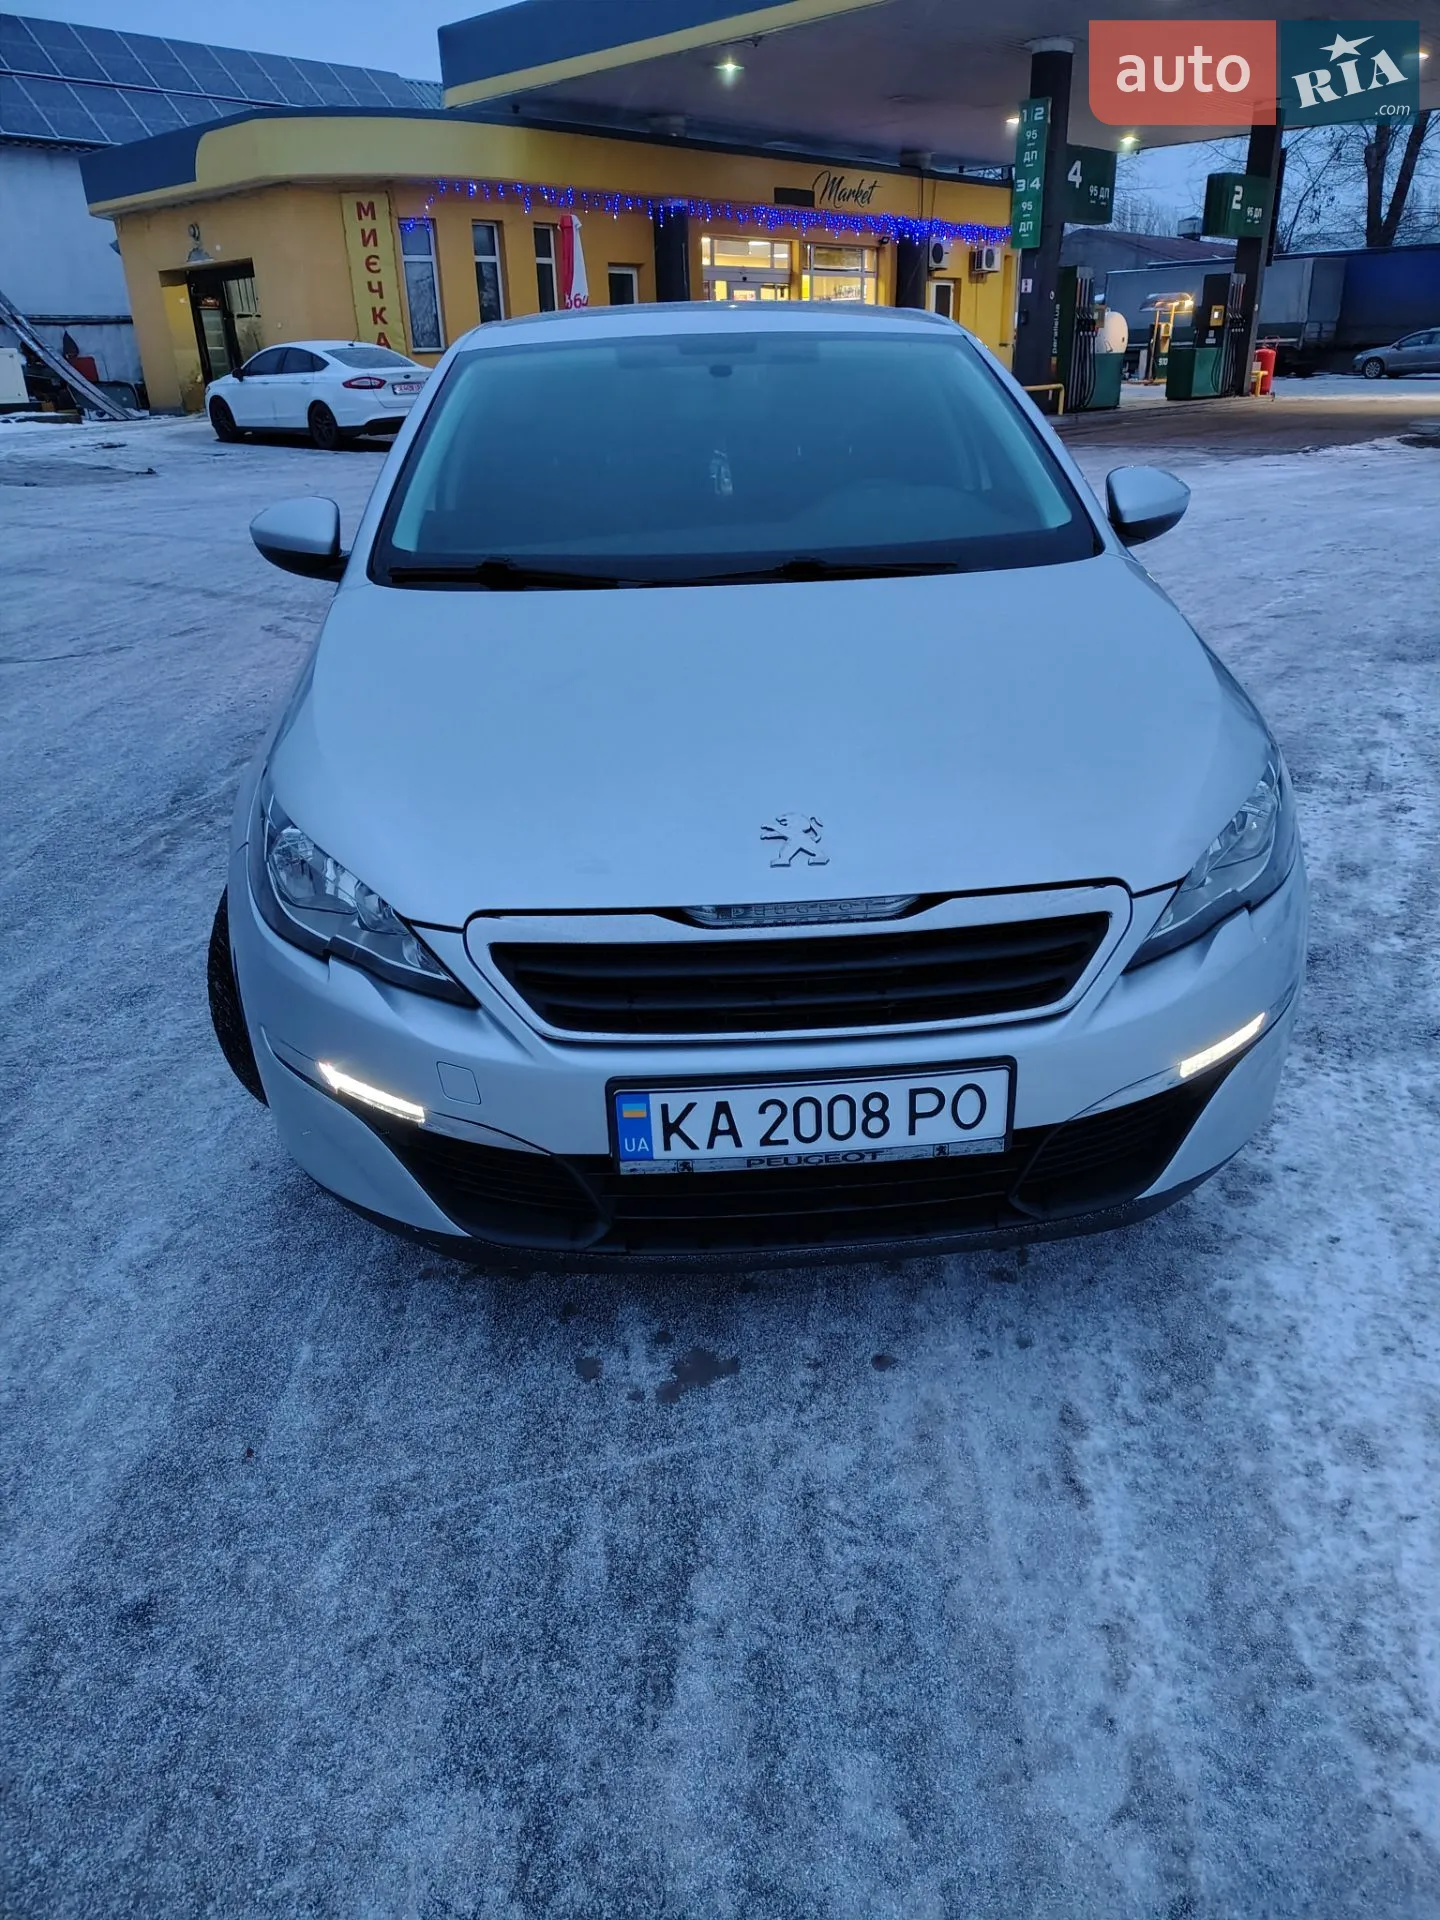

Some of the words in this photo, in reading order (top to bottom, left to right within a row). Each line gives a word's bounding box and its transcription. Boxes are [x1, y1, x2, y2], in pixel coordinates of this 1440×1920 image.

[1025, 129, 1038, 140] 95
[1023, 151, 1038, 163] ДП
[1067, 160, 1082, 189] 4
[812, 170, 882, 208] Market
[1089, 185, 1098, 197] 95
[1099, 187, 1110, 199] ДП
[1231, 185, 1243, 210] 2
[1021, 201, 1033, 212] 95
[1019, 221, 1033, 234] ДП
[660, 1100, 744, 1151] KA
[758, 1092, 891, 1147] 2008
[908, 1083, 988, 1137] PO
[624, 1137, 650, 1152] UA
[746, 1150, 885, 1168] PEUGEOT
